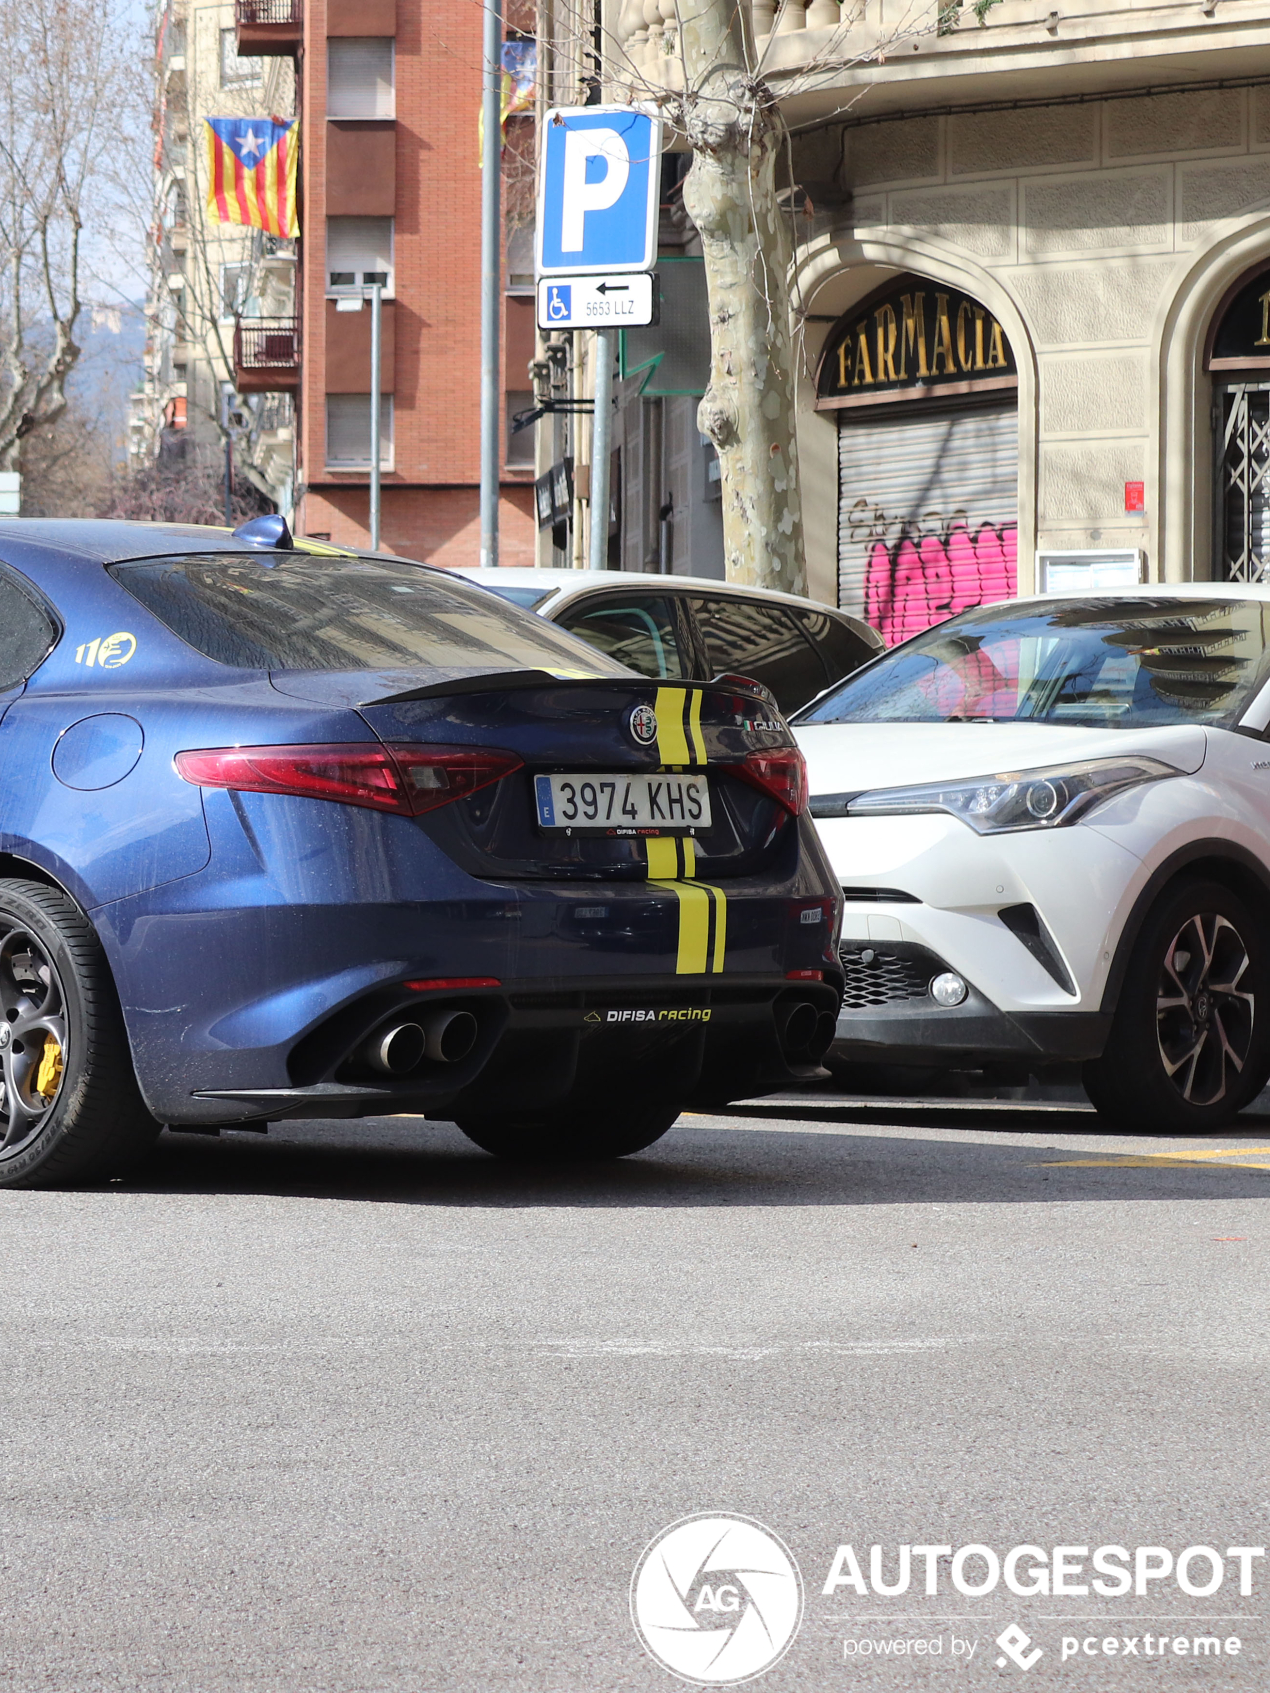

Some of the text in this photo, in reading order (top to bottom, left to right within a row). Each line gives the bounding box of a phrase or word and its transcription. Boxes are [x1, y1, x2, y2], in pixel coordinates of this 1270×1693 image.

[561, 128, 629, 252] P
[586, 300, 634, 316] 5653 LLZ
[837, 292, 1008, 388] FARMACIA
[543, 782, 702, 821] E 3974 KHS
[607, 1008, 711, 1021] DIFISA racing
